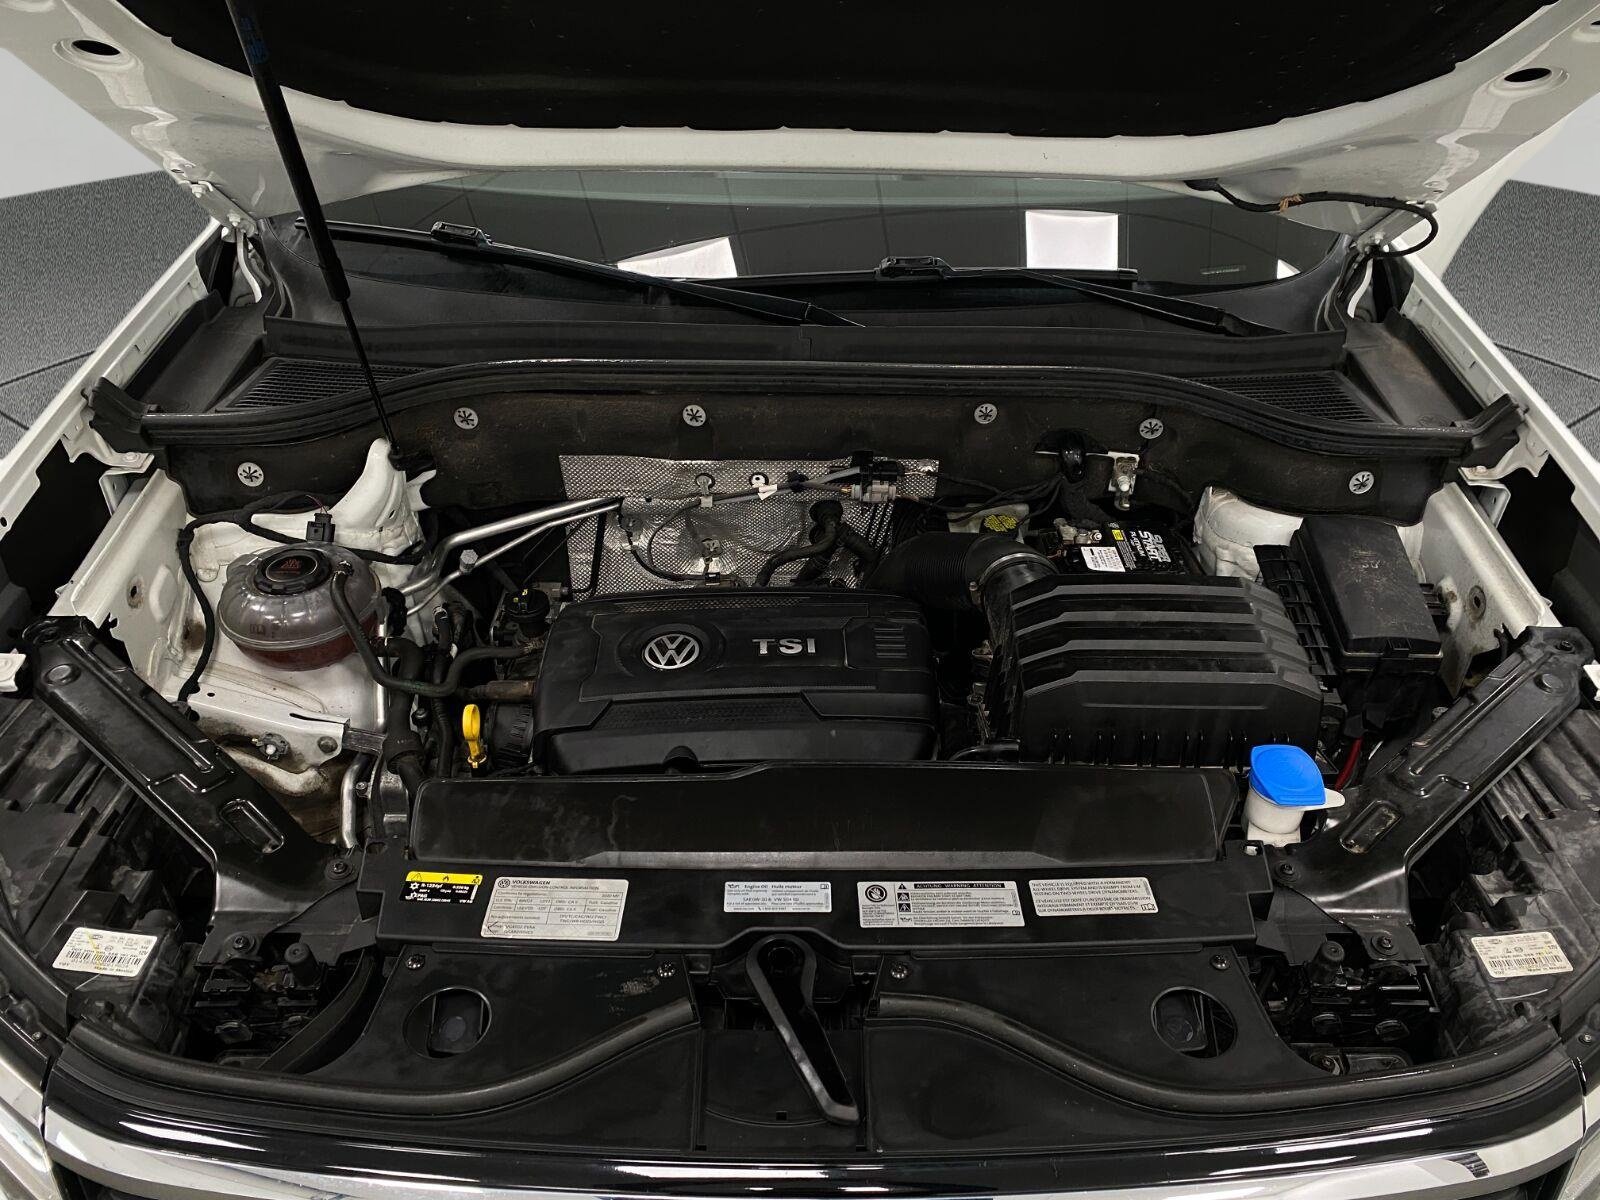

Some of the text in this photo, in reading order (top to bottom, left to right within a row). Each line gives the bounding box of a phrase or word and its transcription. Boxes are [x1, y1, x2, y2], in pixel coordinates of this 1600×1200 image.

[1129, 531, 1147, 558] PLATINUM
[1138, 530, 1158, 560] START
[752, 638, 816, 654] TSI
